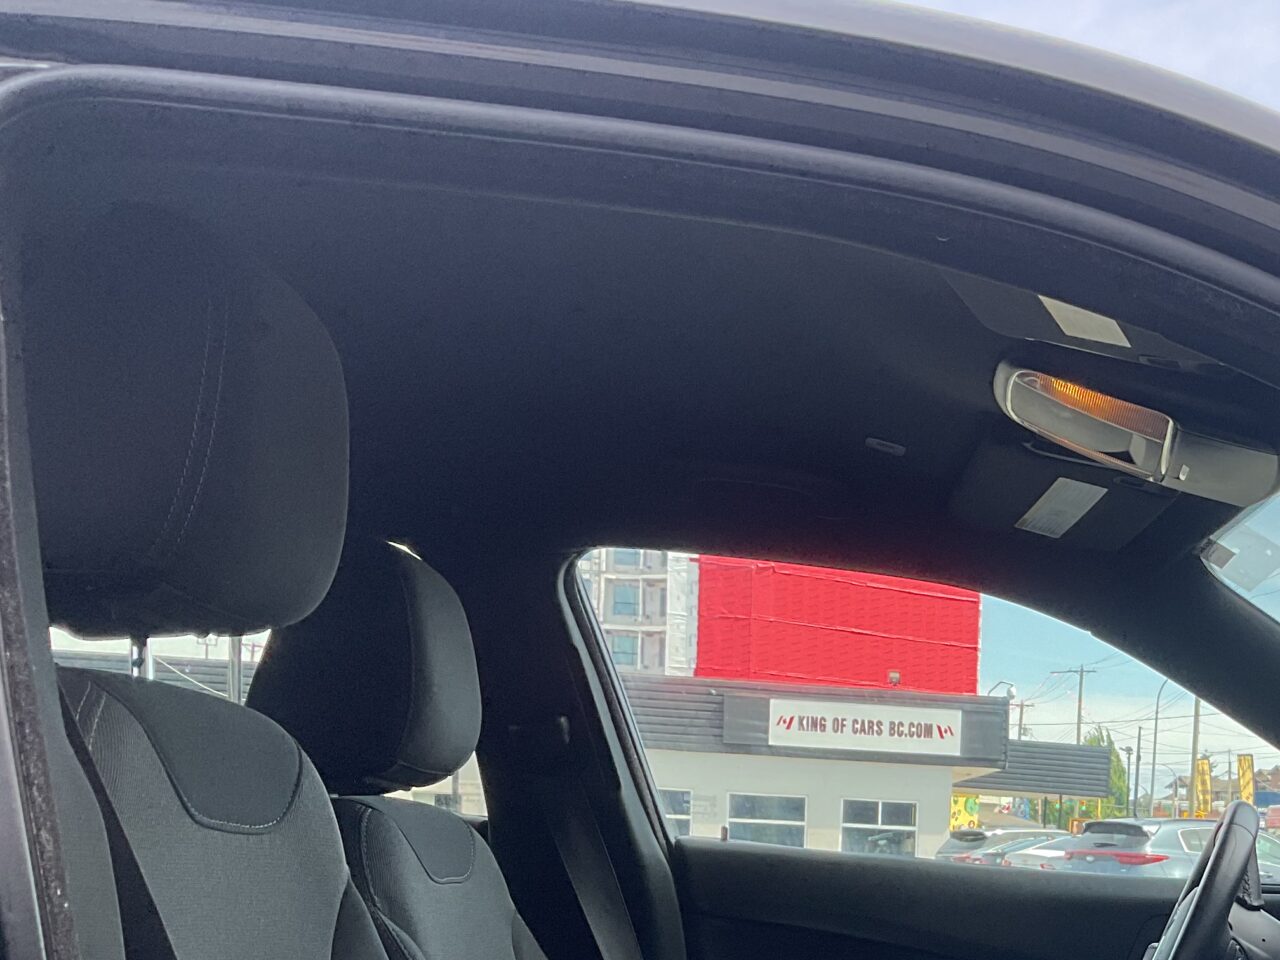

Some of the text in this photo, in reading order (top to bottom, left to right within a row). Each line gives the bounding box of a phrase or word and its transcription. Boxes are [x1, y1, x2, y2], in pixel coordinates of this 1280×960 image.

[798, 715, 934, 739] KING OF CARS BC.COM
